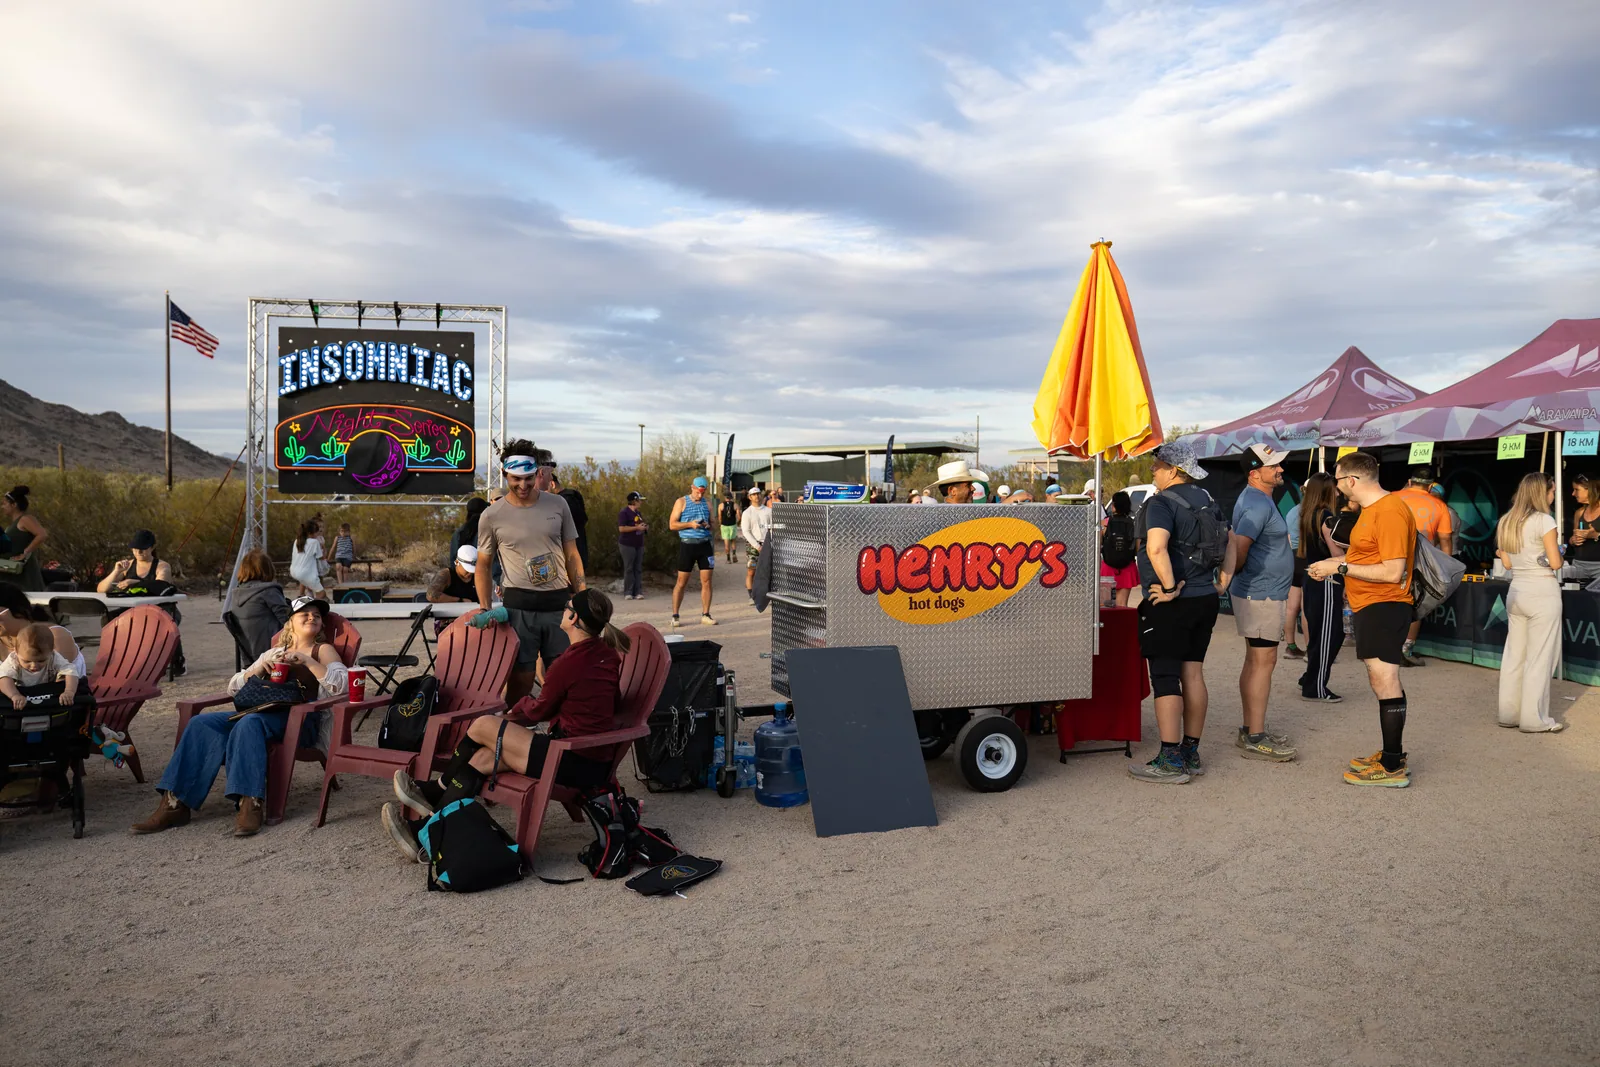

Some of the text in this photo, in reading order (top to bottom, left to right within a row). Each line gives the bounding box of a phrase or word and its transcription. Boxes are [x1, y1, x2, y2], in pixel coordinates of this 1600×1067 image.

[278, 340, 473, 401] INSOMNIAC
[1538, 407, 1598, 421] ARAVAIPA
[299, 408, 451, 453] Night Series
[1502, 442, 1521, 452] 9 KM
[1567, 437, 1594, 447] 18 KM
[1413, 448, 1430, 457] 6 KM
[908, 595, 965, 613] hot dogs
